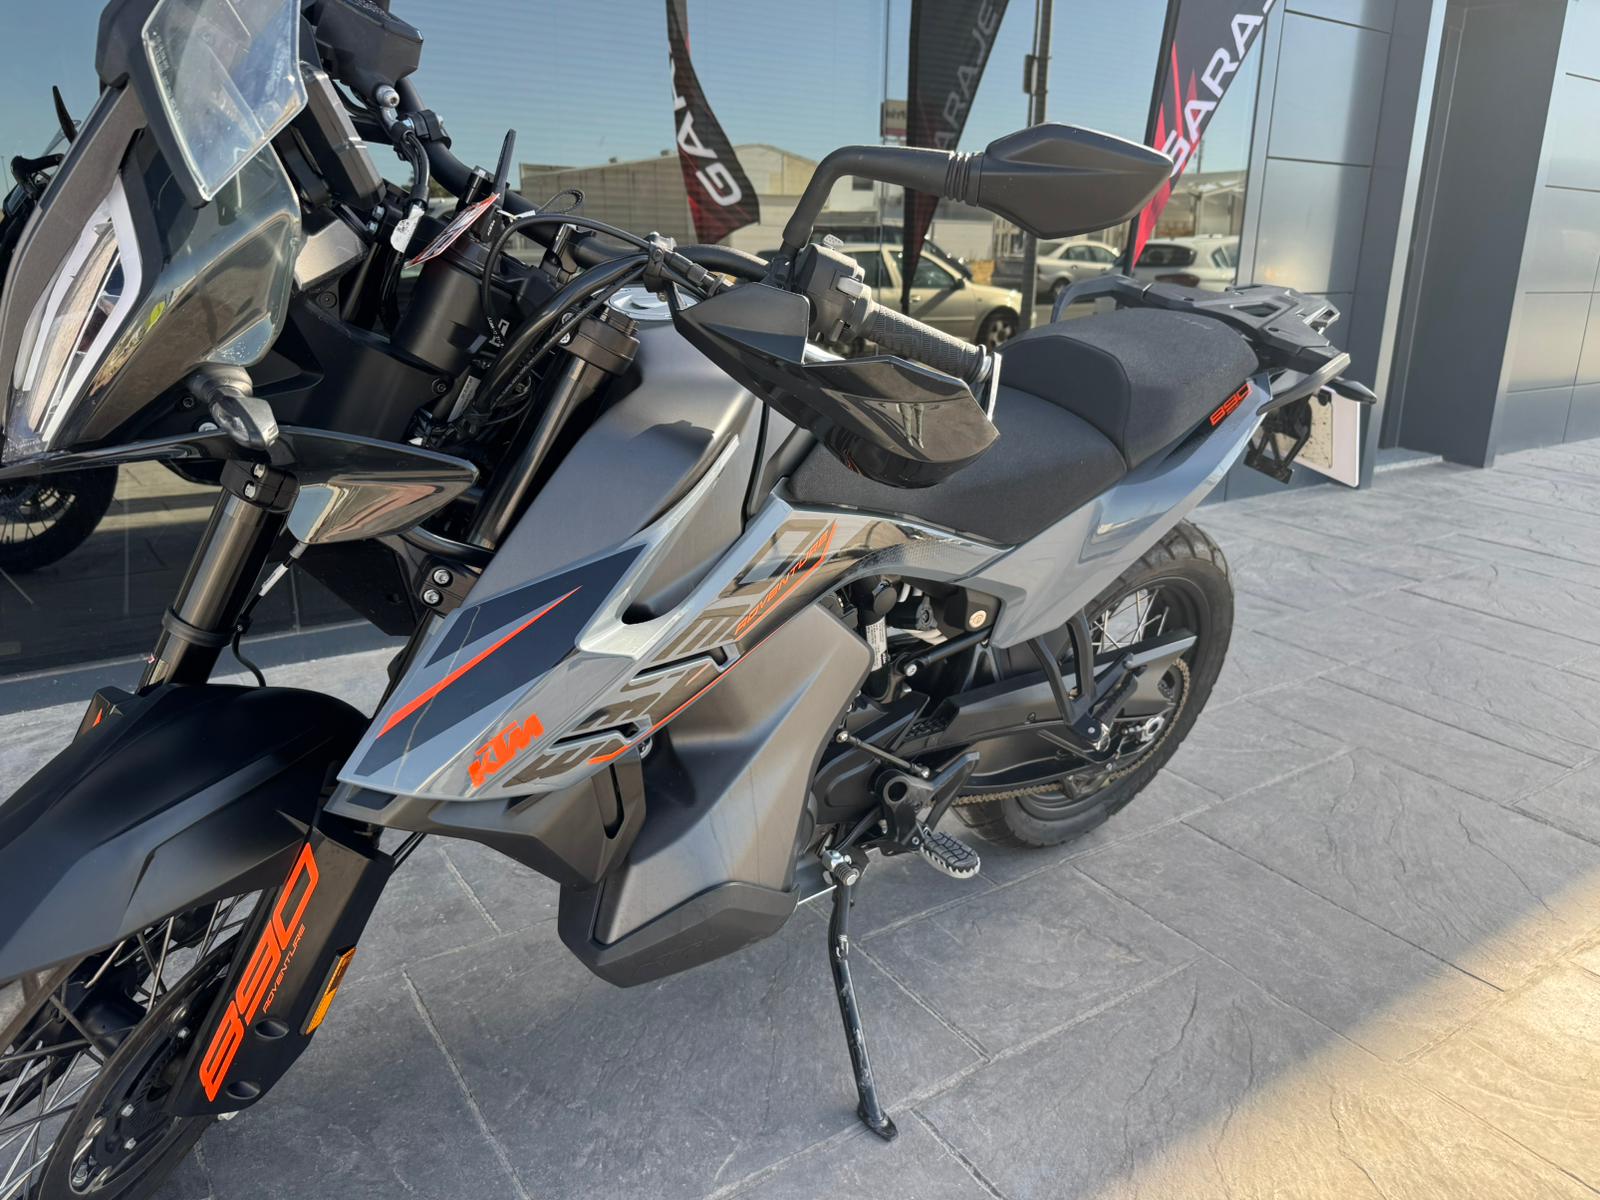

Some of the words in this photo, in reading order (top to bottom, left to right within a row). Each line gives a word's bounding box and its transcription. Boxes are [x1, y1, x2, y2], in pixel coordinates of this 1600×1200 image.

[1209, 383, 1253, 427] 890
[735, 529, 829, 634] ADVENTURE
[467, 713, 545, 788] KTM
[199, 843, 320, 1103] 890
[262, 924, 306, 1014] ADVENTURE
